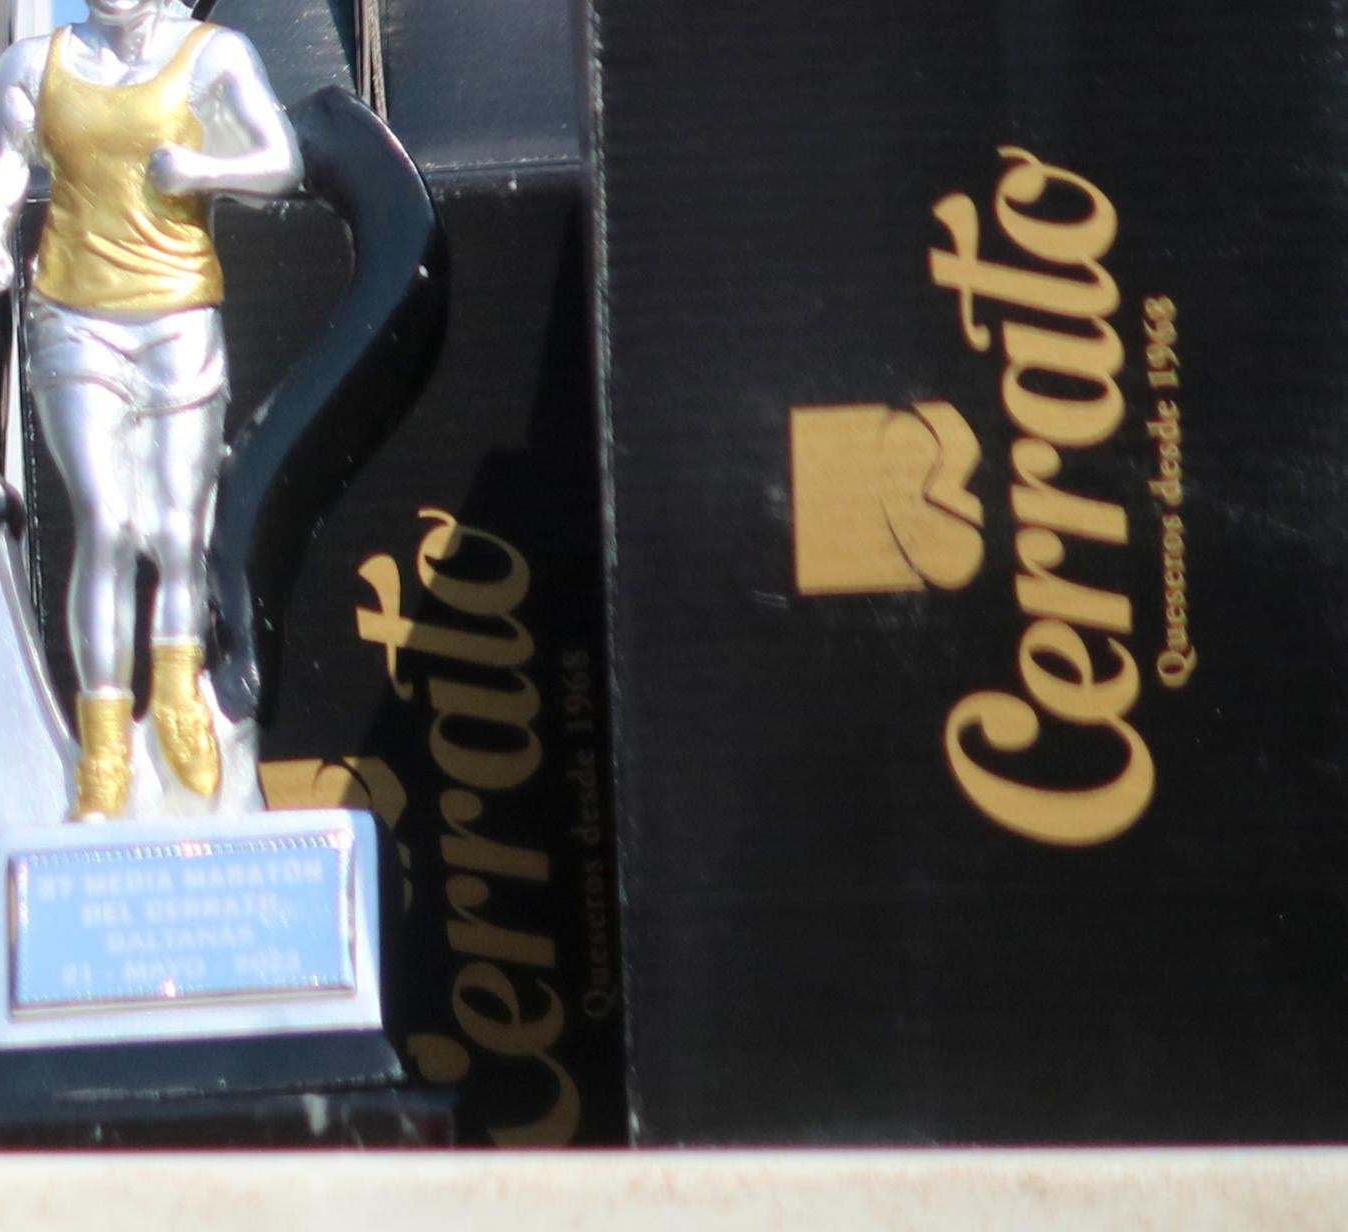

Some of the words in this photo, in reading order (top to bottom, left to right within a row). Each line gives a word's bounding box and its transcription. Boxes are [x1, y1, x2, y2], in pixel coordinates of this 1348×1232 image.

[1144, 295, 1179, 389] 1968
[926, 144, 1158, 848] Cerrato
[1146, 399, 1183, 509] desde
[1157, 512, 1198, 689] Queseros
[561, 649, 593, 732] 1968
[568, 749, 603, 847] desde
[81, 901, 132, 927] DEL
[145, 893, 279, 922] CERRATO
[83, 869, 173, 897] MEDIA
[581, 858, 619, 1020] Queseros
